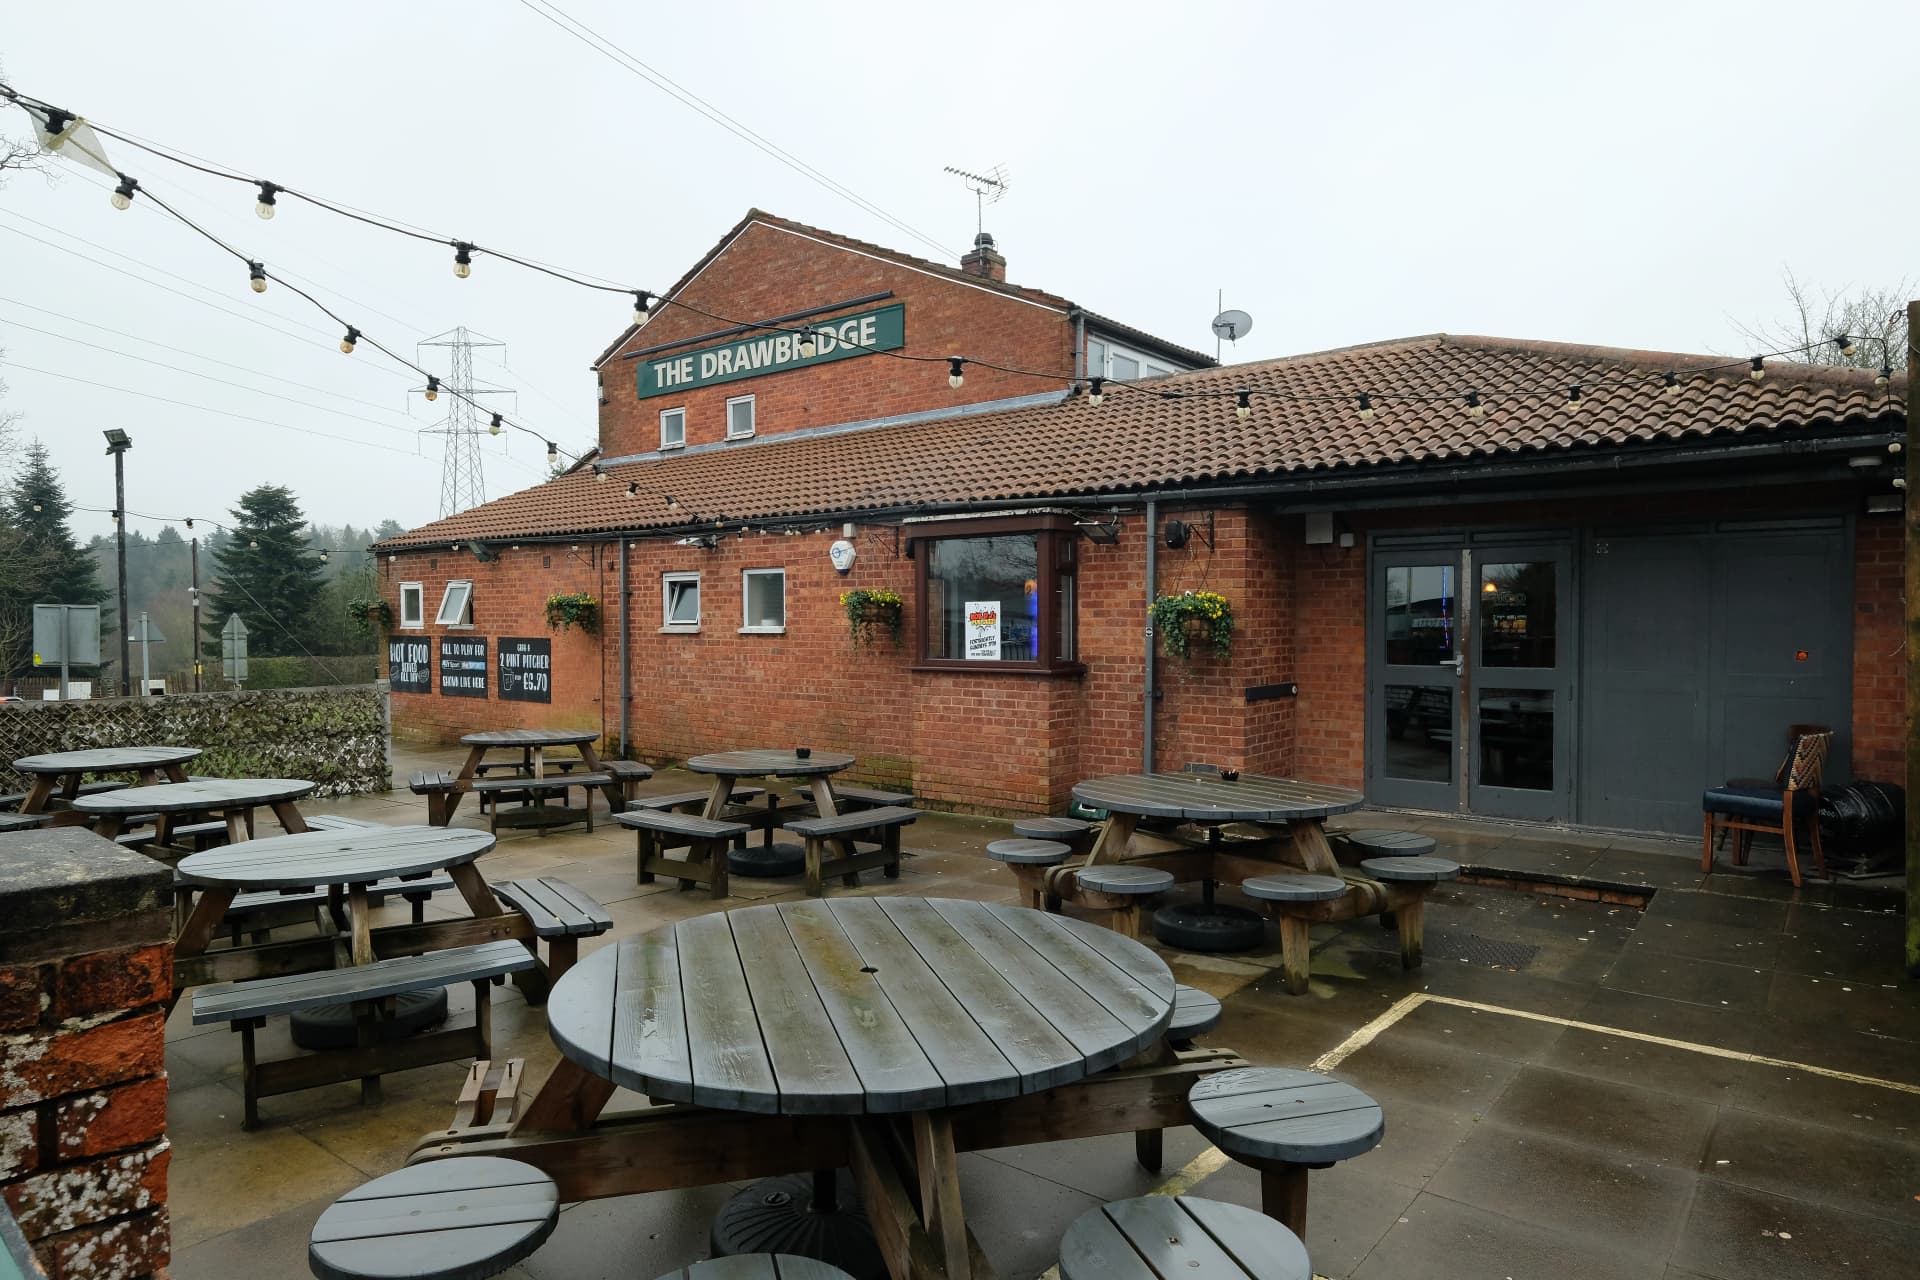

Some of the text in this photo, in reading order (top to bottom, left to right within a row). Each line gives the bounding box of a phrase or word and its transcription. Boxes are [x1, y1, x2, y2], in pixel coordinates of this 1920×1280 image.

[654, 357, 694, 388] THE
[390, 643, 429, 664] HOT FOOD
[442, 643, 485, 656] ALL TO PLAY FOR
[499, 652, 504, 667] 2
[506, 653, 520, 667] PINT
[522, 654, 550, 669] PITCHER
[442, 676, 486, 689] SHOWN LIVE HERE
[523, 672, 548, 692] £6.70
